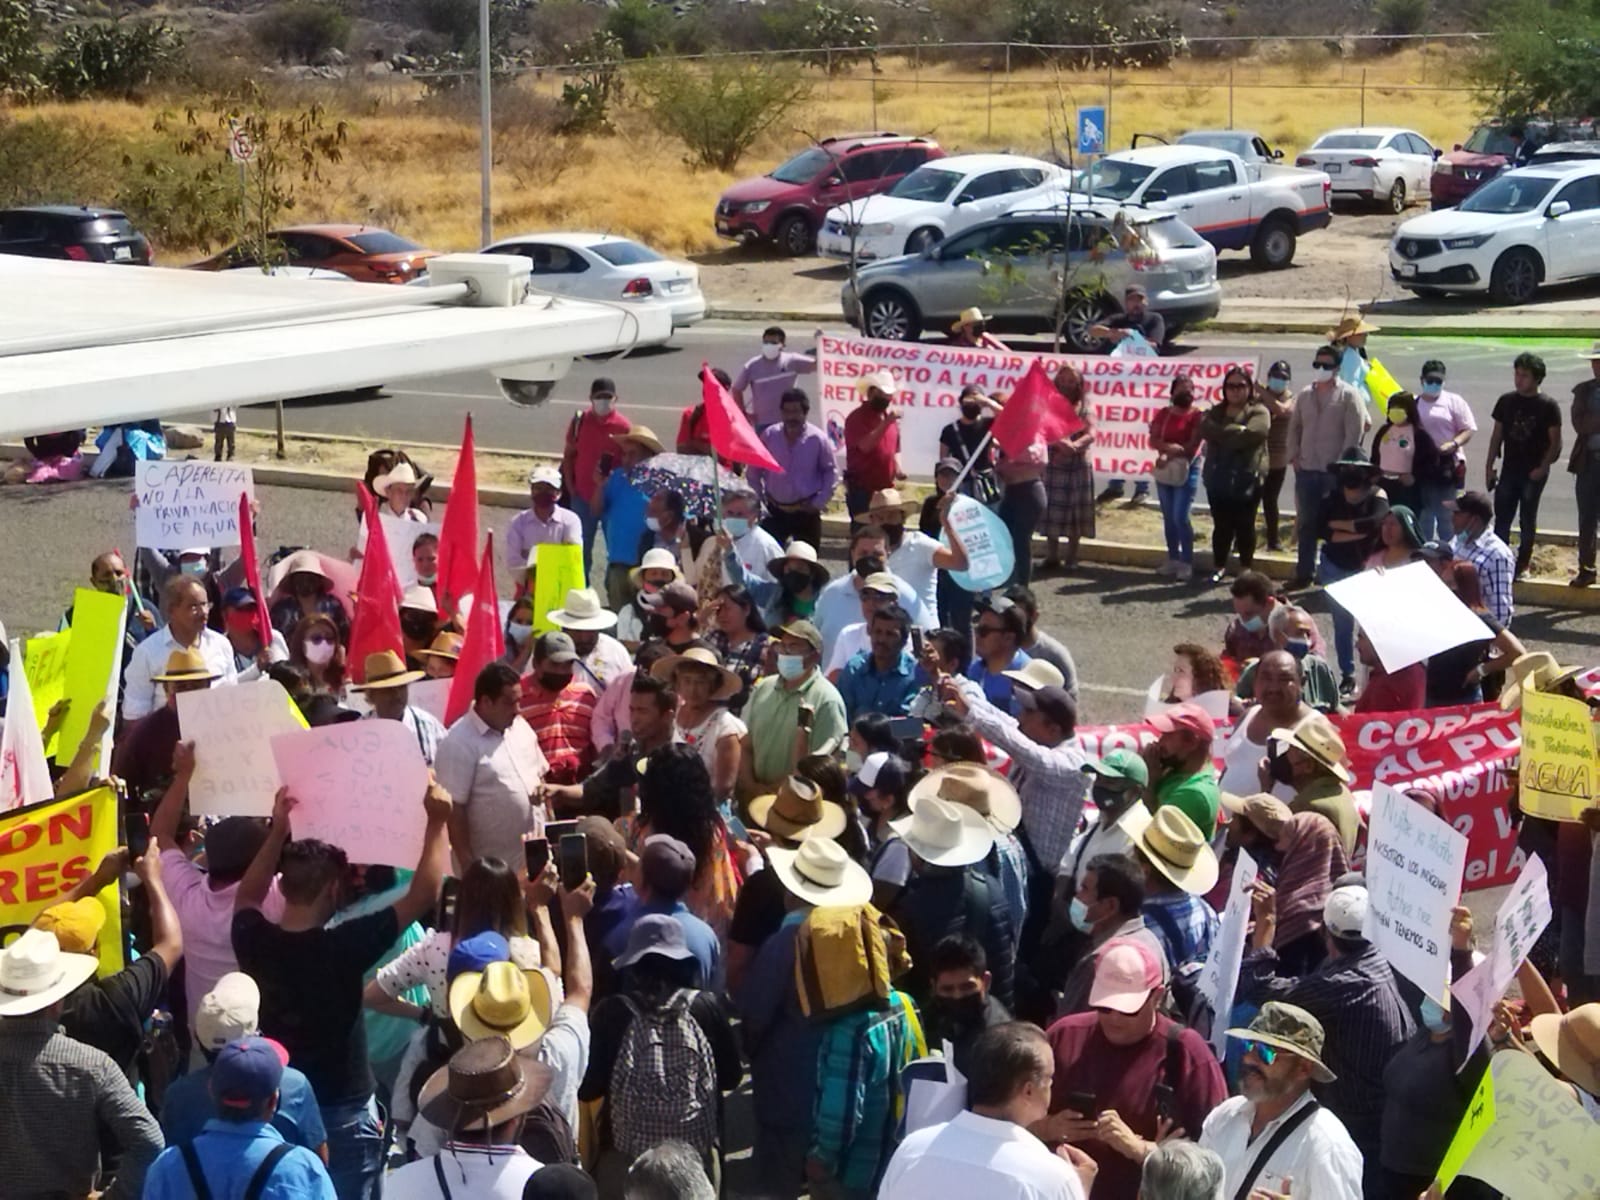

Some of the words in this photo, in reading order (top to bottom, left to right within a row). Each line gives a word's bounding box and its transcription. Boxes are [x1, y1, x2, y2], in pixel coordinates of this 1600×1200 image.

[822, 337, 920, 361] EXIGIMOS
[925, 349, 1024, 371] CUMPLIR
[1082, 361, 1124, 376] LOS
[823, 360, 931, 383] RESPECTO
[938, 370, 952, 385] A
[960, 372, 988, 388] LA
[824, 384, 915, 408] RETAR
[924, 391, 960, 408] LO
[1094, 457, 1157, 477] LICA
[142, 489, 165, 506] NO
[154, 501, 238, 520] PRIVATIZACIO
[161, 522, 184, 537] DE
[192, 518, 237, 539] AGUA
[1374, 747, 1444, 781] AL
[1448, 721, 1521, 761] PU
[1524, 758, 1591, 796] AGUA
